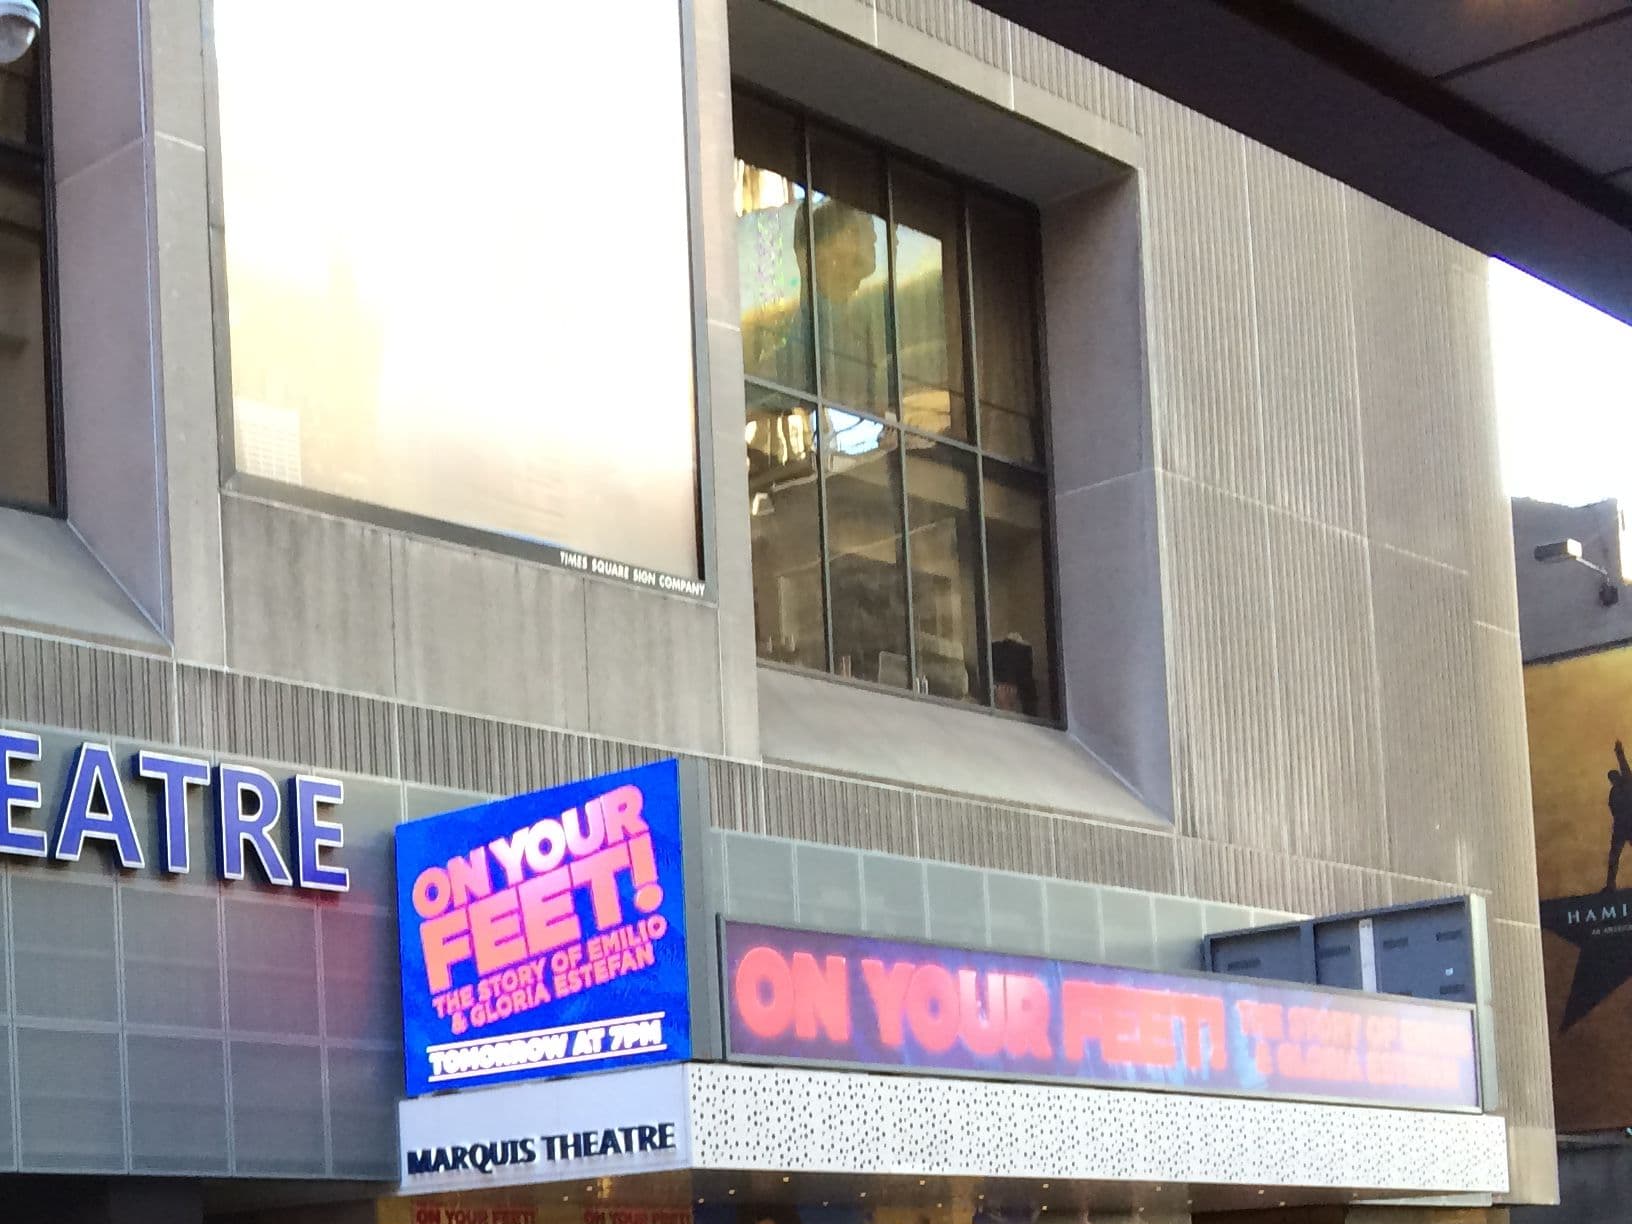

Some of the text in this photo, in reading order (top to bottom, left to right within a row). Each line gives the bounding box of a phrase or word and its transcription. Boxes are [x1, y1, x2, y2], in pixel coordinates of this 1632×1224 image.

[559, 551, 706, 597] TIMES SQUARE SIGN COMPANY
[412, 784, 651, 920] ON YOUR
[419, 834, 665, 995] FEET!
[1567, 903, 1628, 924] HAMI
[432, 914, 668, 1019] THE STORY OF EMILIO
[451, 941, 656, 1035] & GLORIA ESTEFAN
[735, 946, 850, 1041] ON
[861, 957, 1053, 1061] YOUR
[428, 1019, 663, 1077] TOMORROW AT 7PM
[407, 1122, 676, 1176] MARQUIS THEATRE
